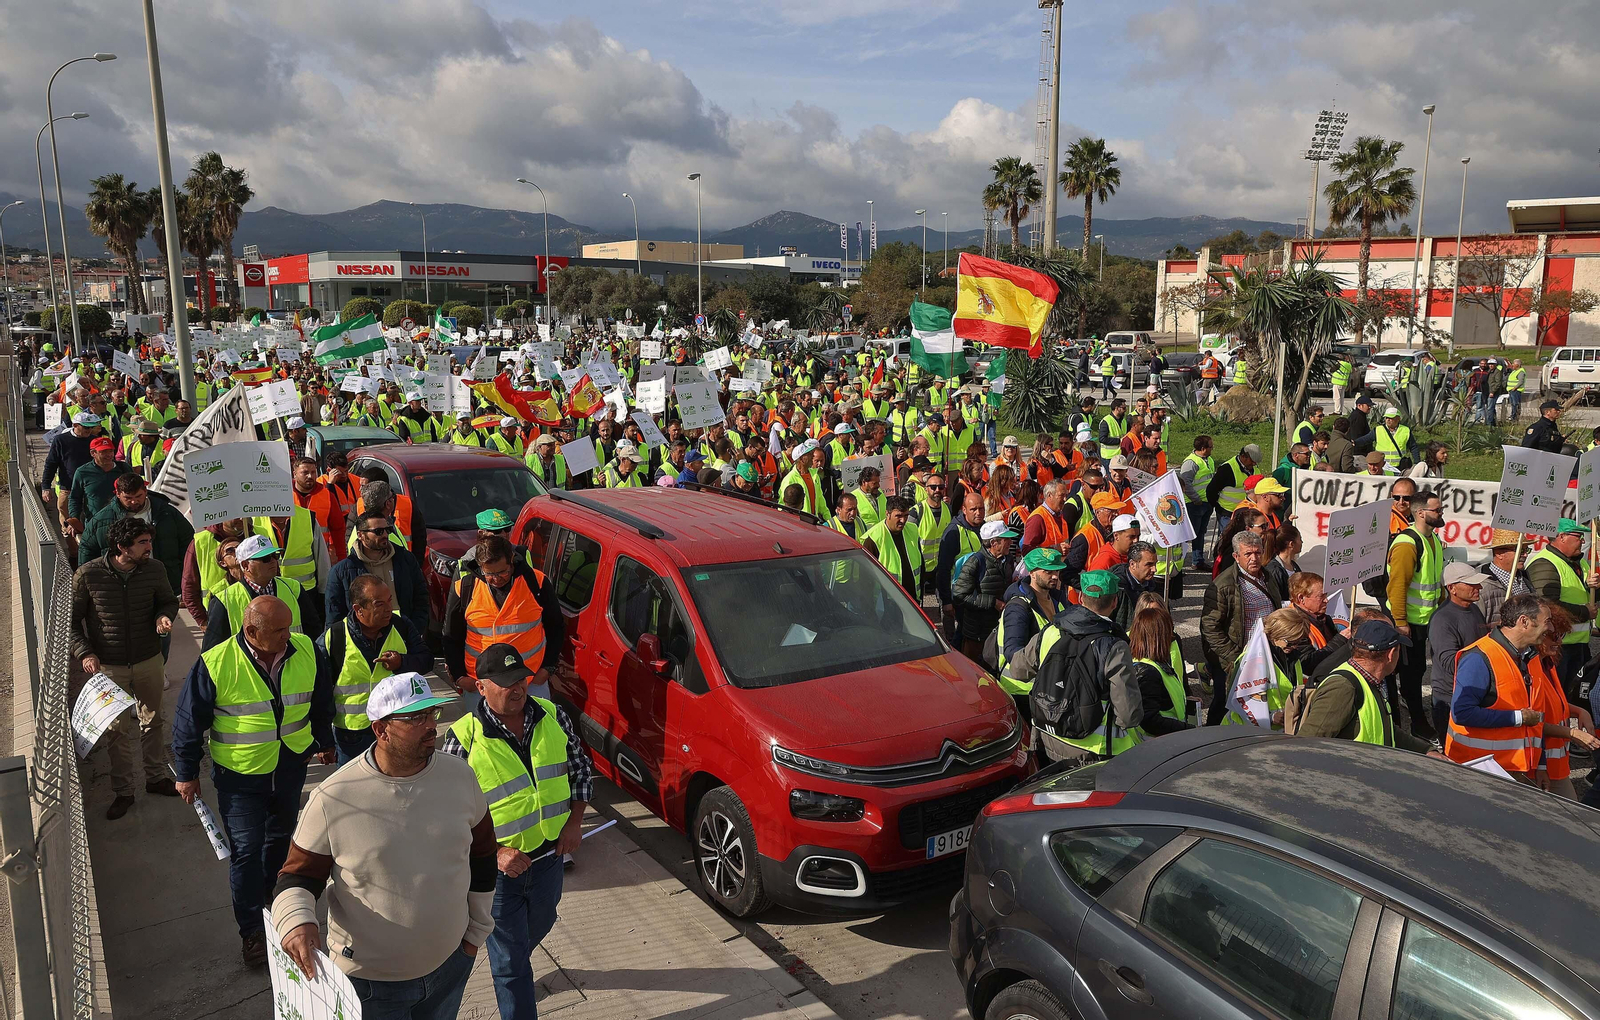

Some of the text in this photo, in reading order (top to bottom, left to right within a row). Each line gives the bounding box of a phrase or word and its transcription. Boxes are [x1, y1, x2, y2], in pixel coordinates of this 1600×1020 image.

[812, 261, 841, 269] IVECO
[337, 265, 394, 275] NISSAN
[409, 265, 470, 276] NISSAN
[191, 460, 222, 472] COAG
[1508, 462, 1528, 471] COAG
[213, 482, 228, 490] UPA
[1513, 488, 1524, 496] UPA
[1452, 489, 1486, 516] DE
[243, 504, 291, 514] Campo Vivo
[204, 513, 216, 521] Por
[1498, 515, 1507, 524] Por
[1332, 524, 1355, 535] COAG
[1526, 520, 1557, 532] Campo Vivo
[1371, 564, 1382, 573] Vivo
[1330, 577, 1340, 586] Por
